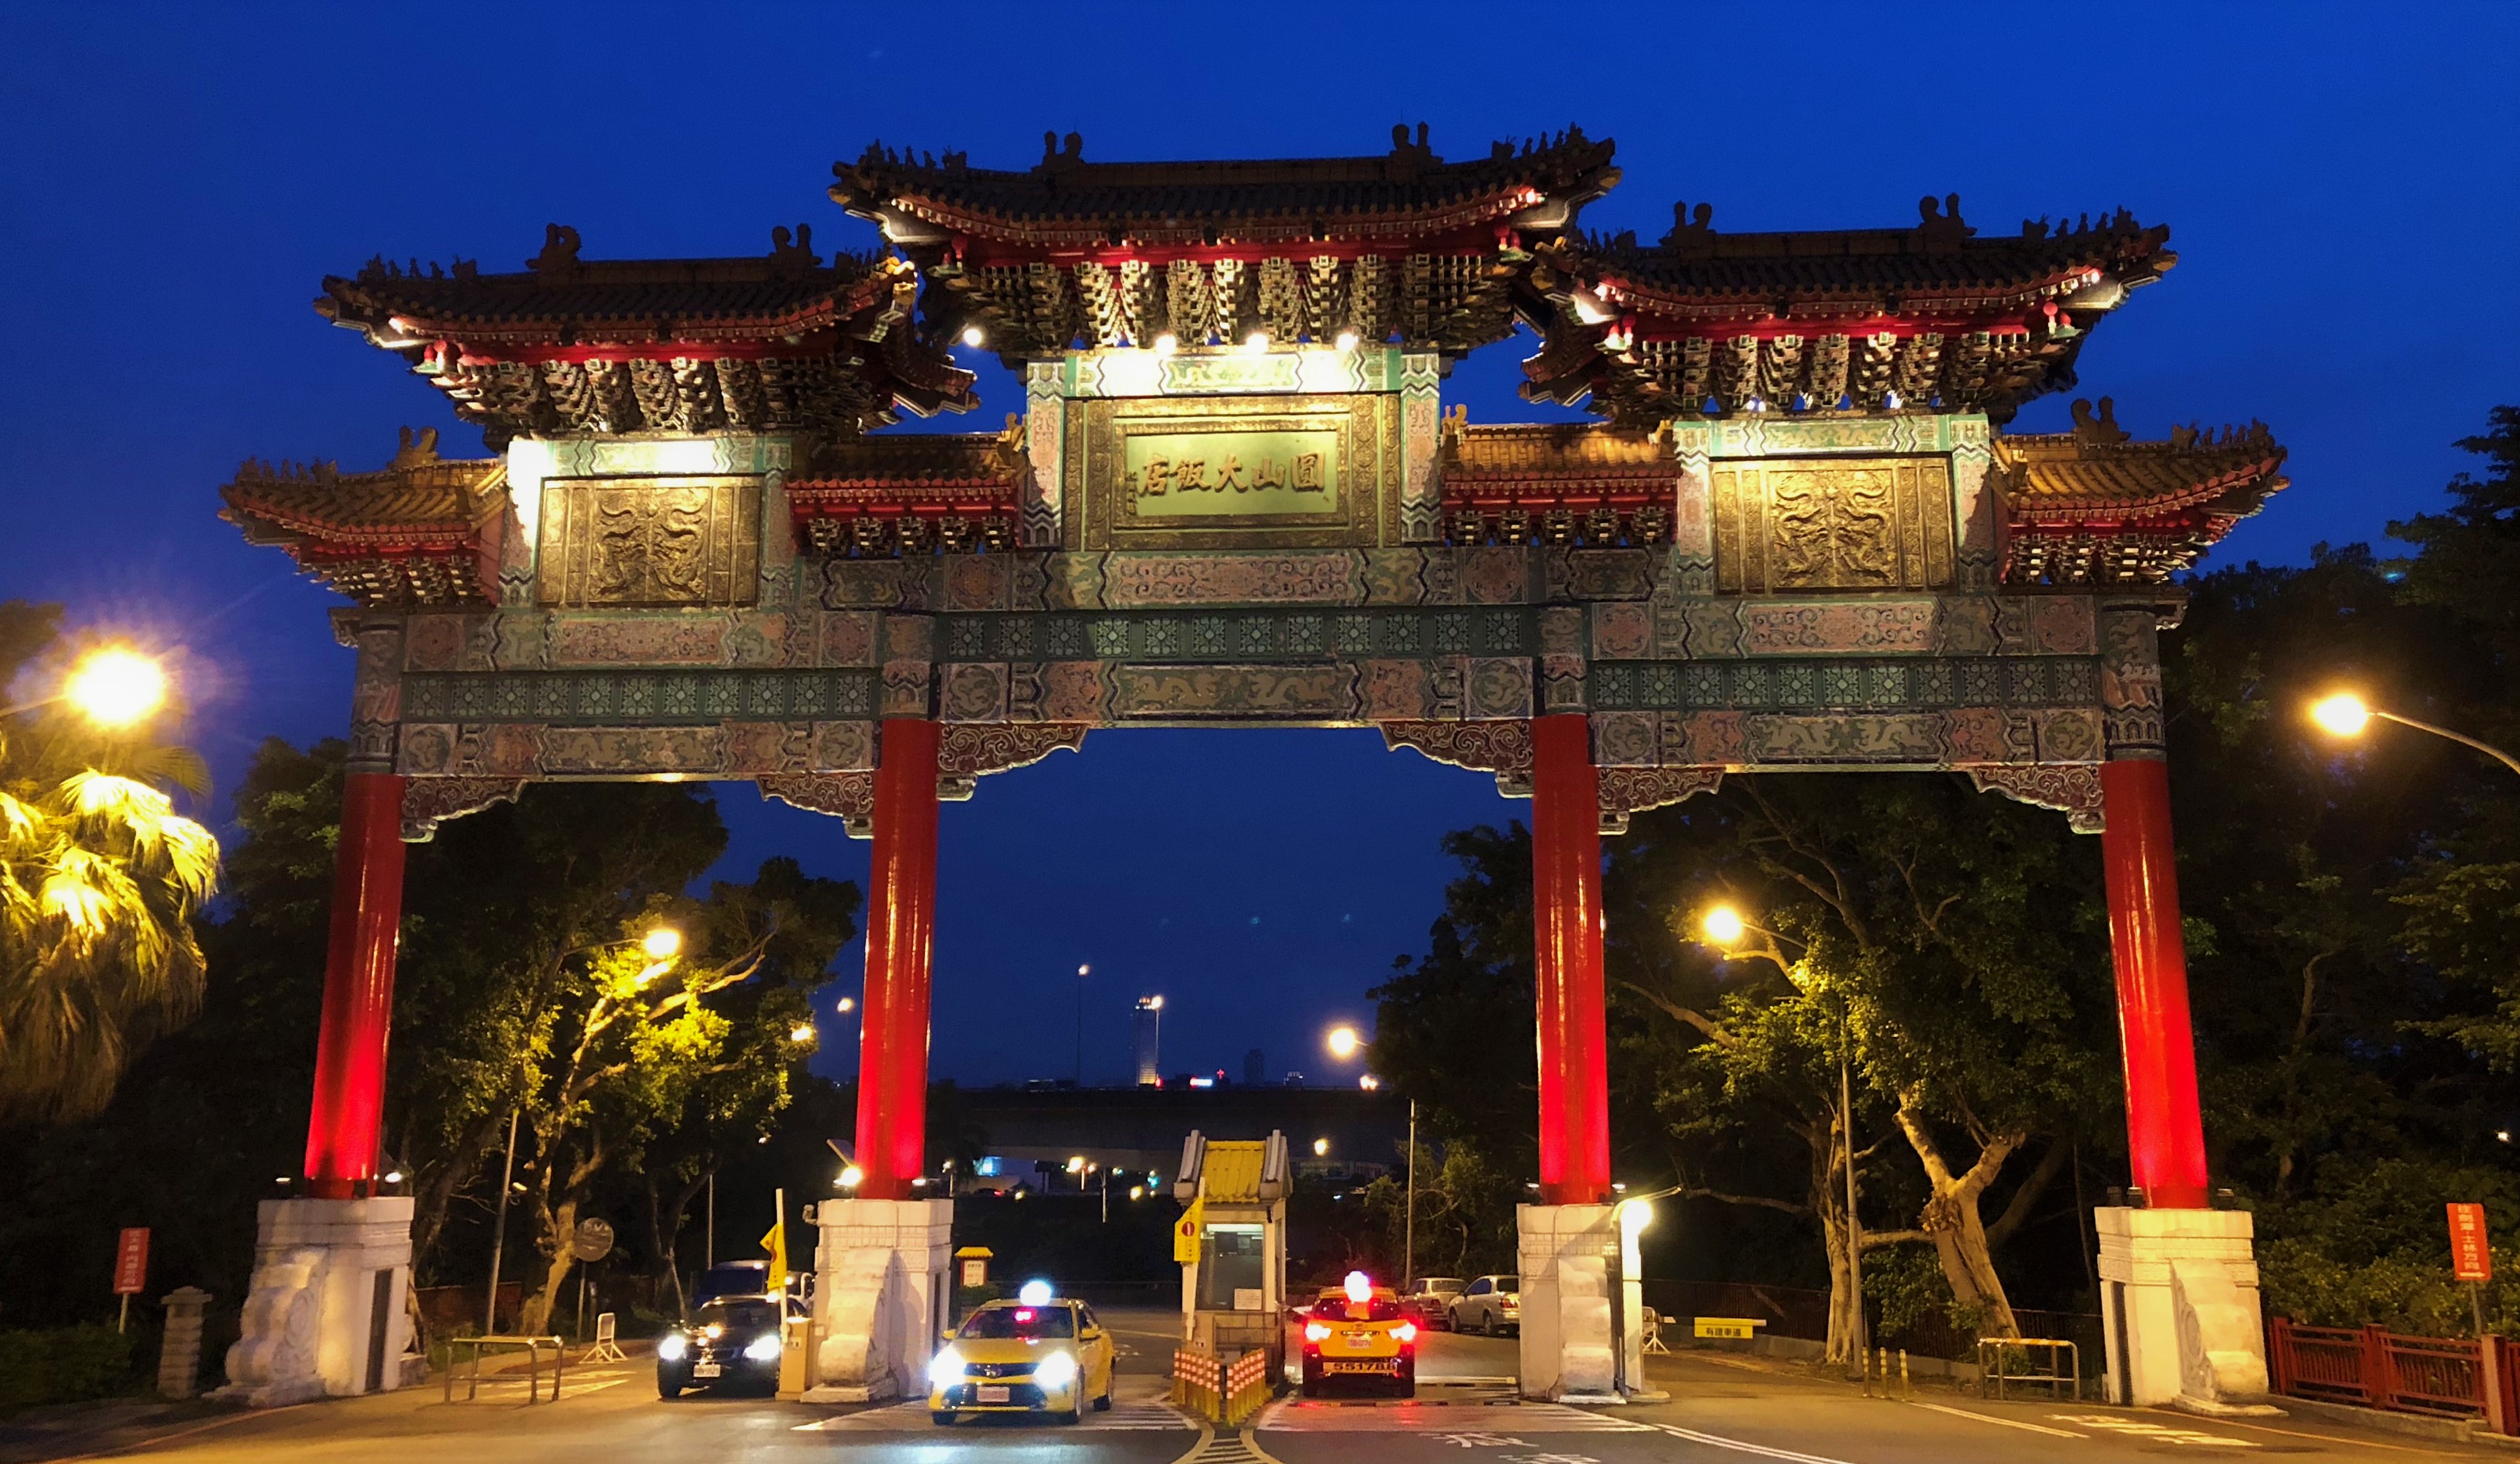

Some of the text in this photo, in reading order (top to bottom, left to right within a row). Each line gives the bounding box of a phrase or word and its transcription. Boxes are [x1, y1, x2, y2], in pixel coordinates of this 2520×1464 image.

[1137, 453, 1326, 496] 圓山大飯店
